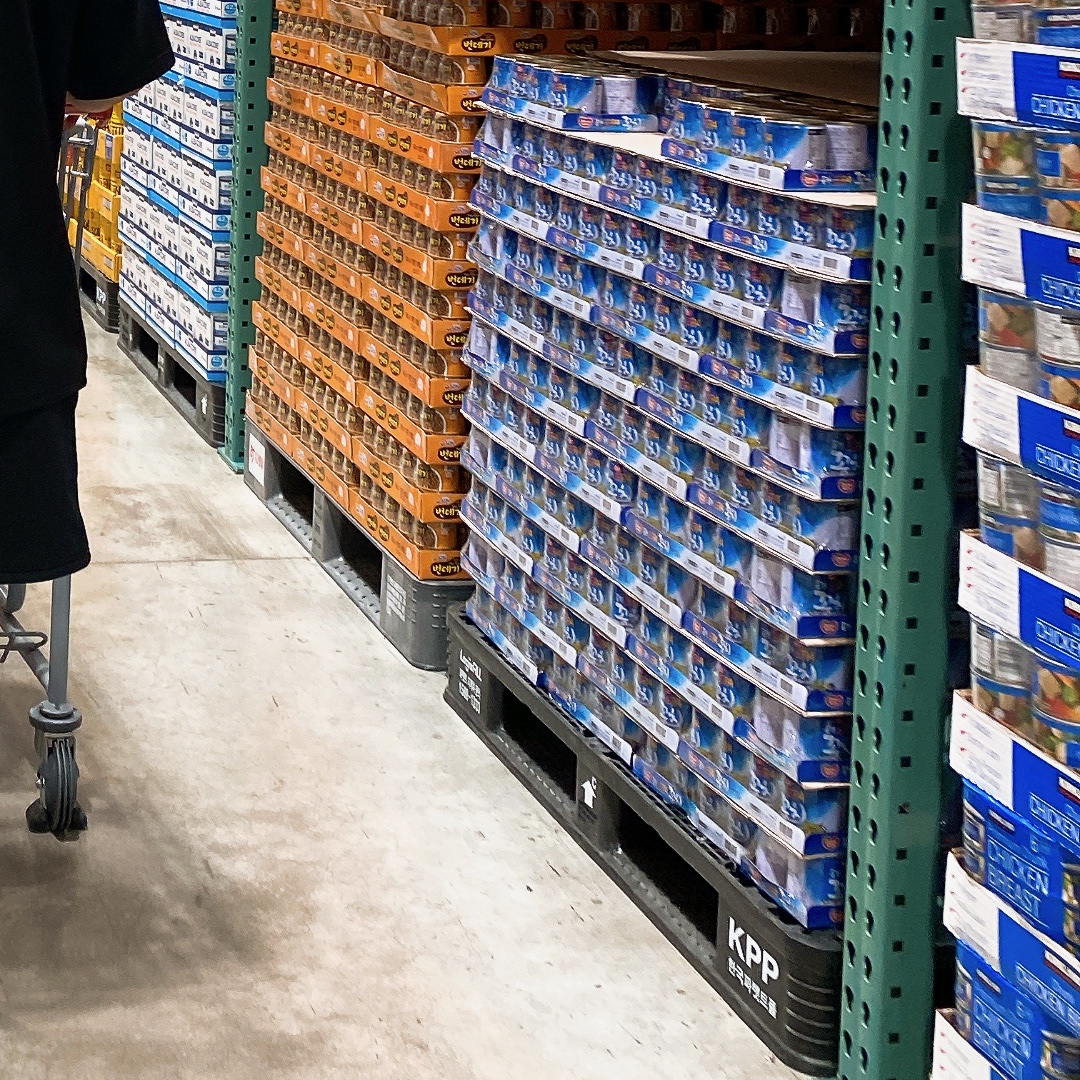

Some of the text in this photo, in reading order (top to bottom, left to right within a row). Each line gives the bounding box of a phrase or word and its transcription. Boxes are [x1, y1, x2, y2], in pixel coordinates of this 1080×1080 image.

[462, 39, 492, 51] 번데기
[450, 216, 479, 227] 번데기
[447, 276, 475, 287] 번데기
[445, 393, 464, 404] 번데
[440, 449, 460, 460] 번데
[433, 563, 460, 575] 번데기
[987, 838, 1049, 897] CHICKEN
[987, 863, 1039, 918] BREAST
[728, 916, 779, 985] KPP
[973, 998, 1032, 1059] CHICKEN
